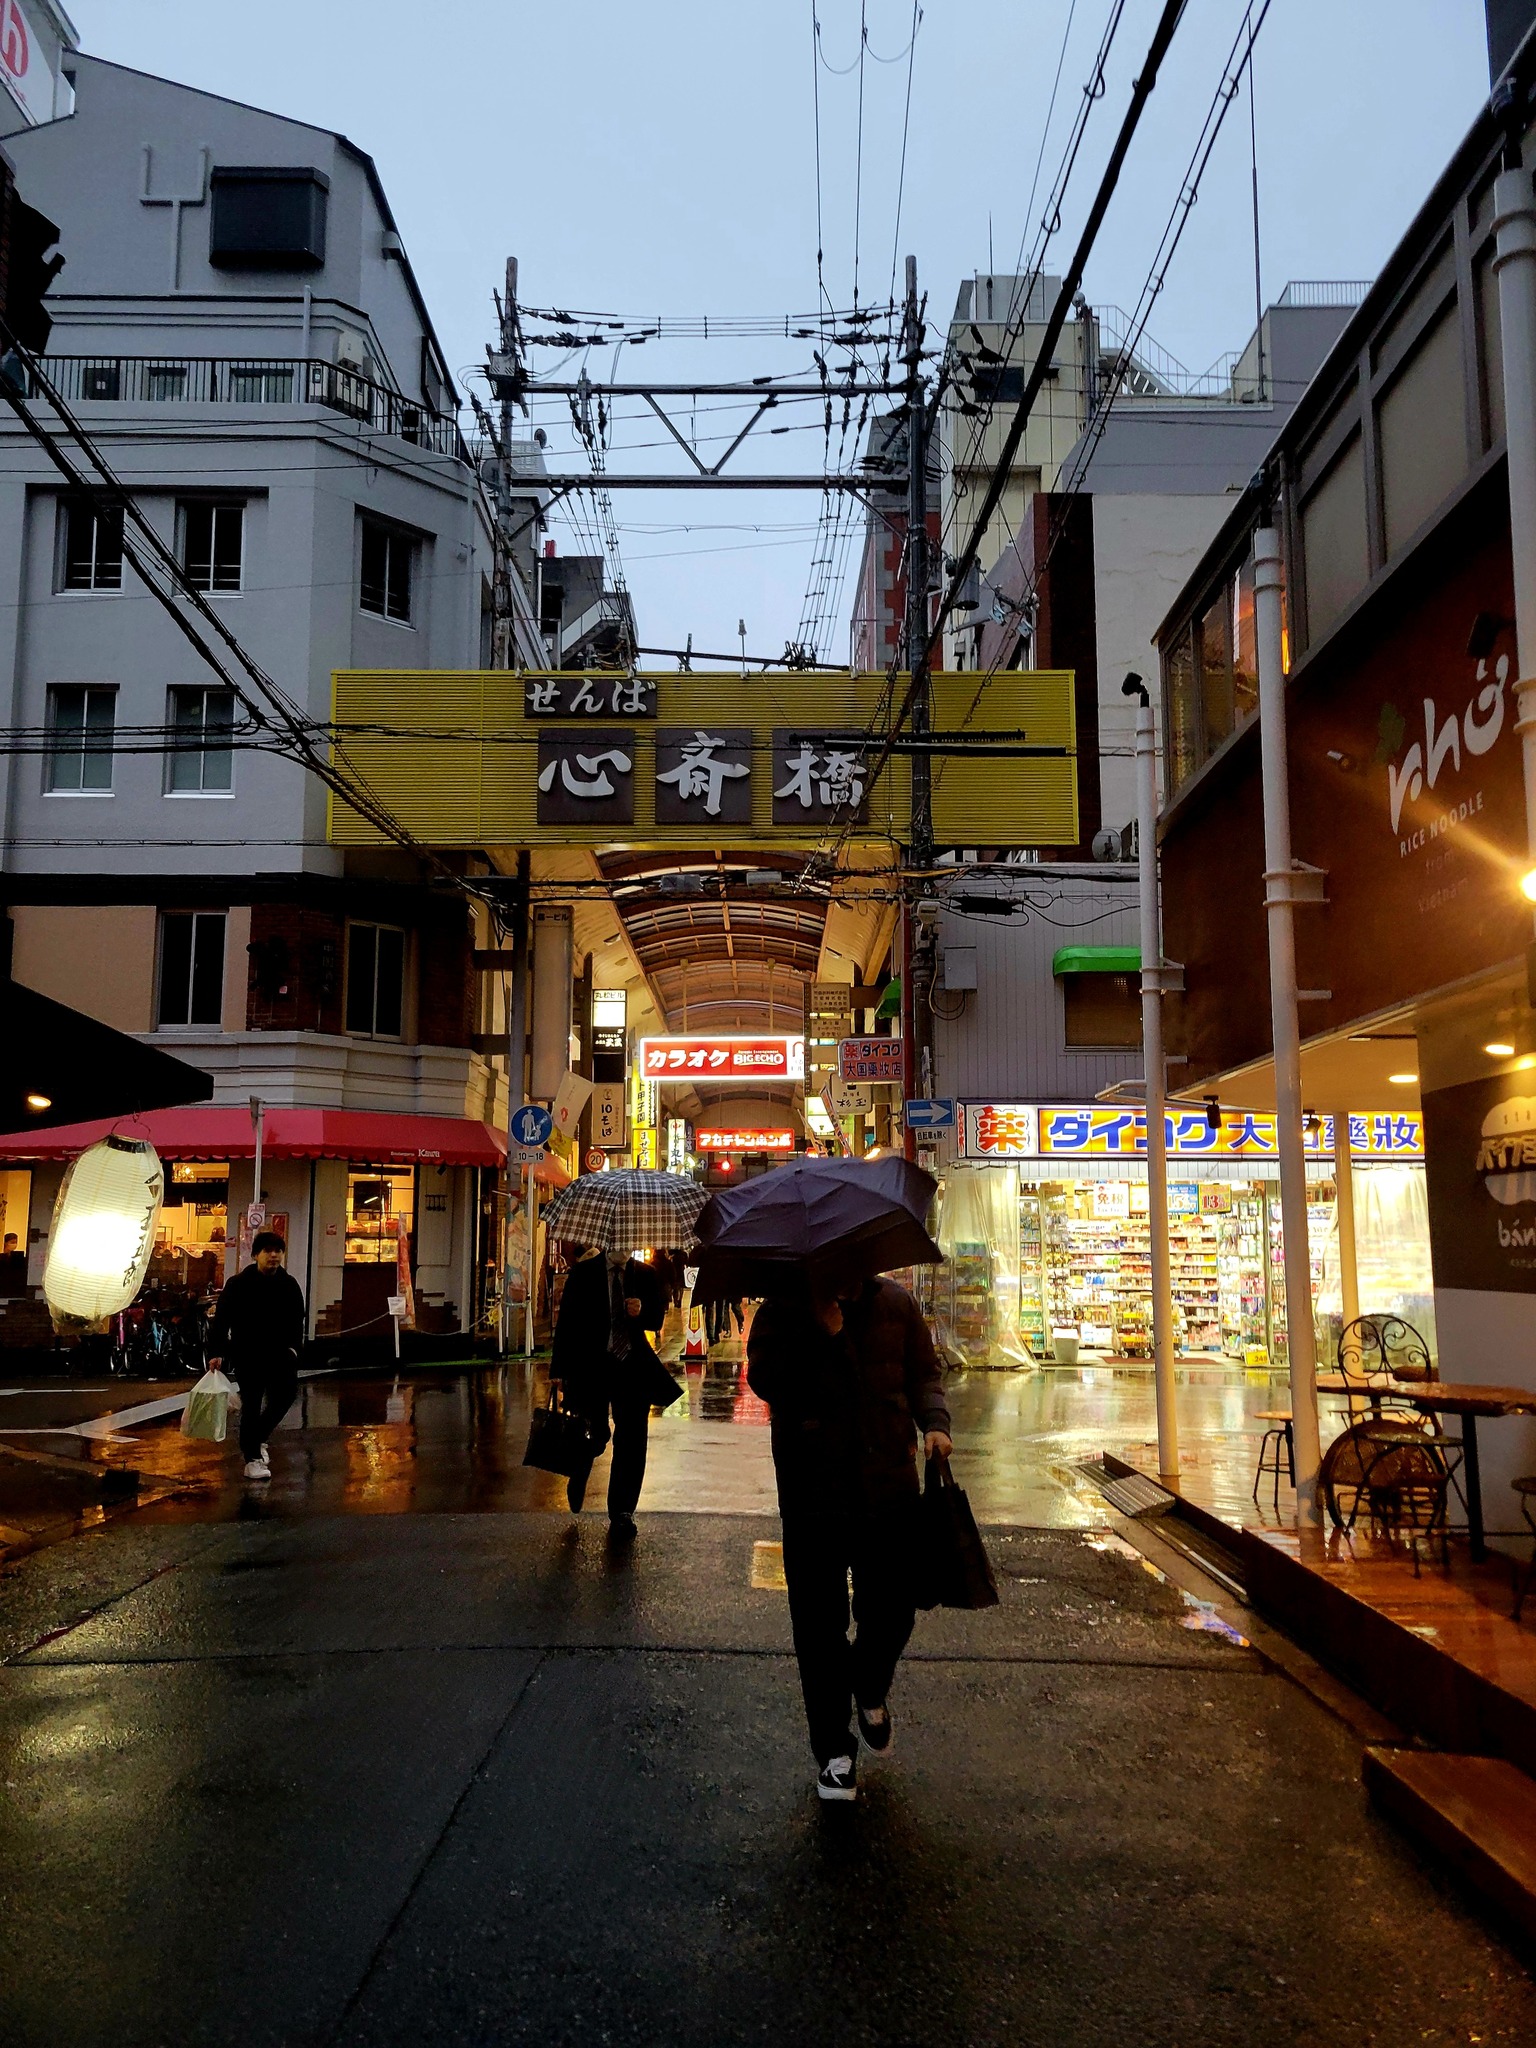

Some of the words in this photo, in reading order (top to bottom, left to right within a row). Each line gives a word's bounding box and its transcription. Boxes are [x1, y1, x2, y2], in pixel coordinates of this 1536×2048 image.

[525, 679, 657, 714] せんば
[537, 731, 868, 816] 心斎橋
[1400, 828, 1425, 858] RICE
[1430, 790, 1484, 838] NOODLE
[647, 1049, 730, 1068] カラオケ
[733, 1053, 754, 1066] BIG
[755, 1053, 784, 1065] ECHO
[862, 1043, 901, 1057] ダイコク
[917, 1130, 947, 1141] 自転車を除く
[974, 1105, 1031, 1155] 薬
[590, 1155, 601, 1165] 20
